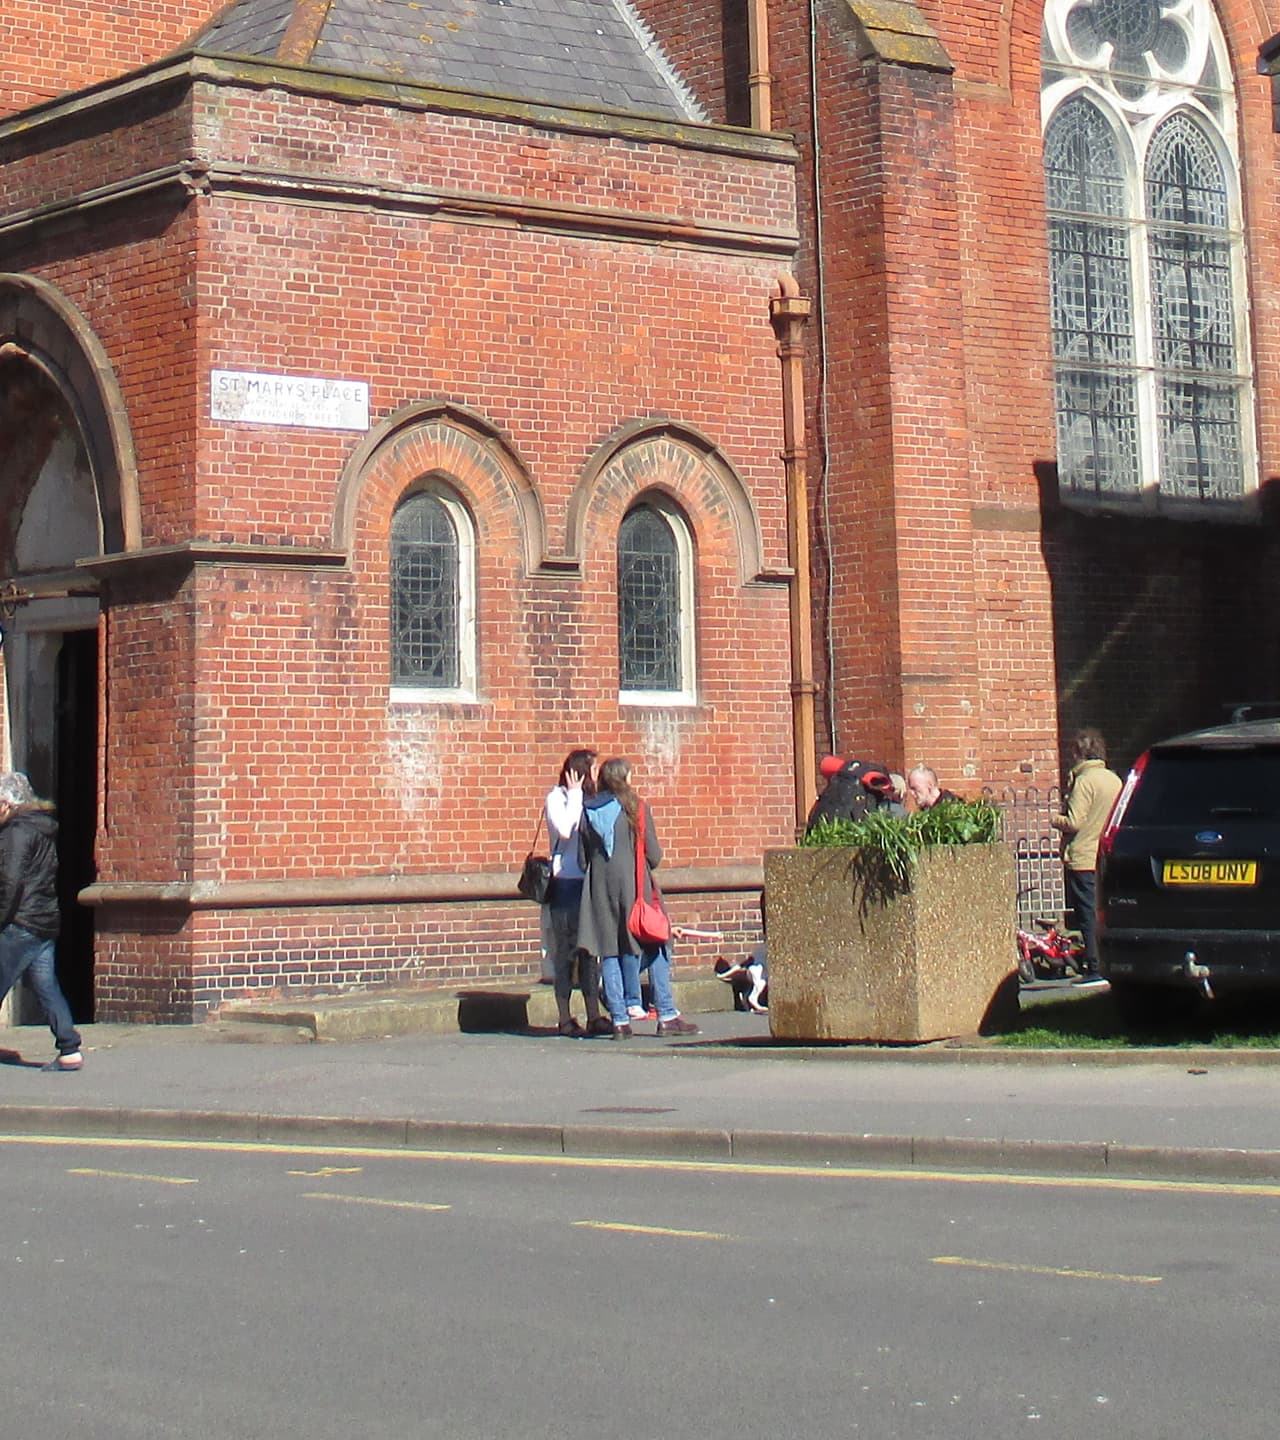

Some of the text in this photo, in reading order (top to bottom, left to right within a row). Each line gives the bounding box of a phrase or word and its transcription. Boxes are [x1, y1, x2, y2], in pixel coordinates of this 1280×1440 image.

[218, 376, 362, 402] ST MARYS PLACE
[1169, 863, 1249, 880] LS08 UNV
